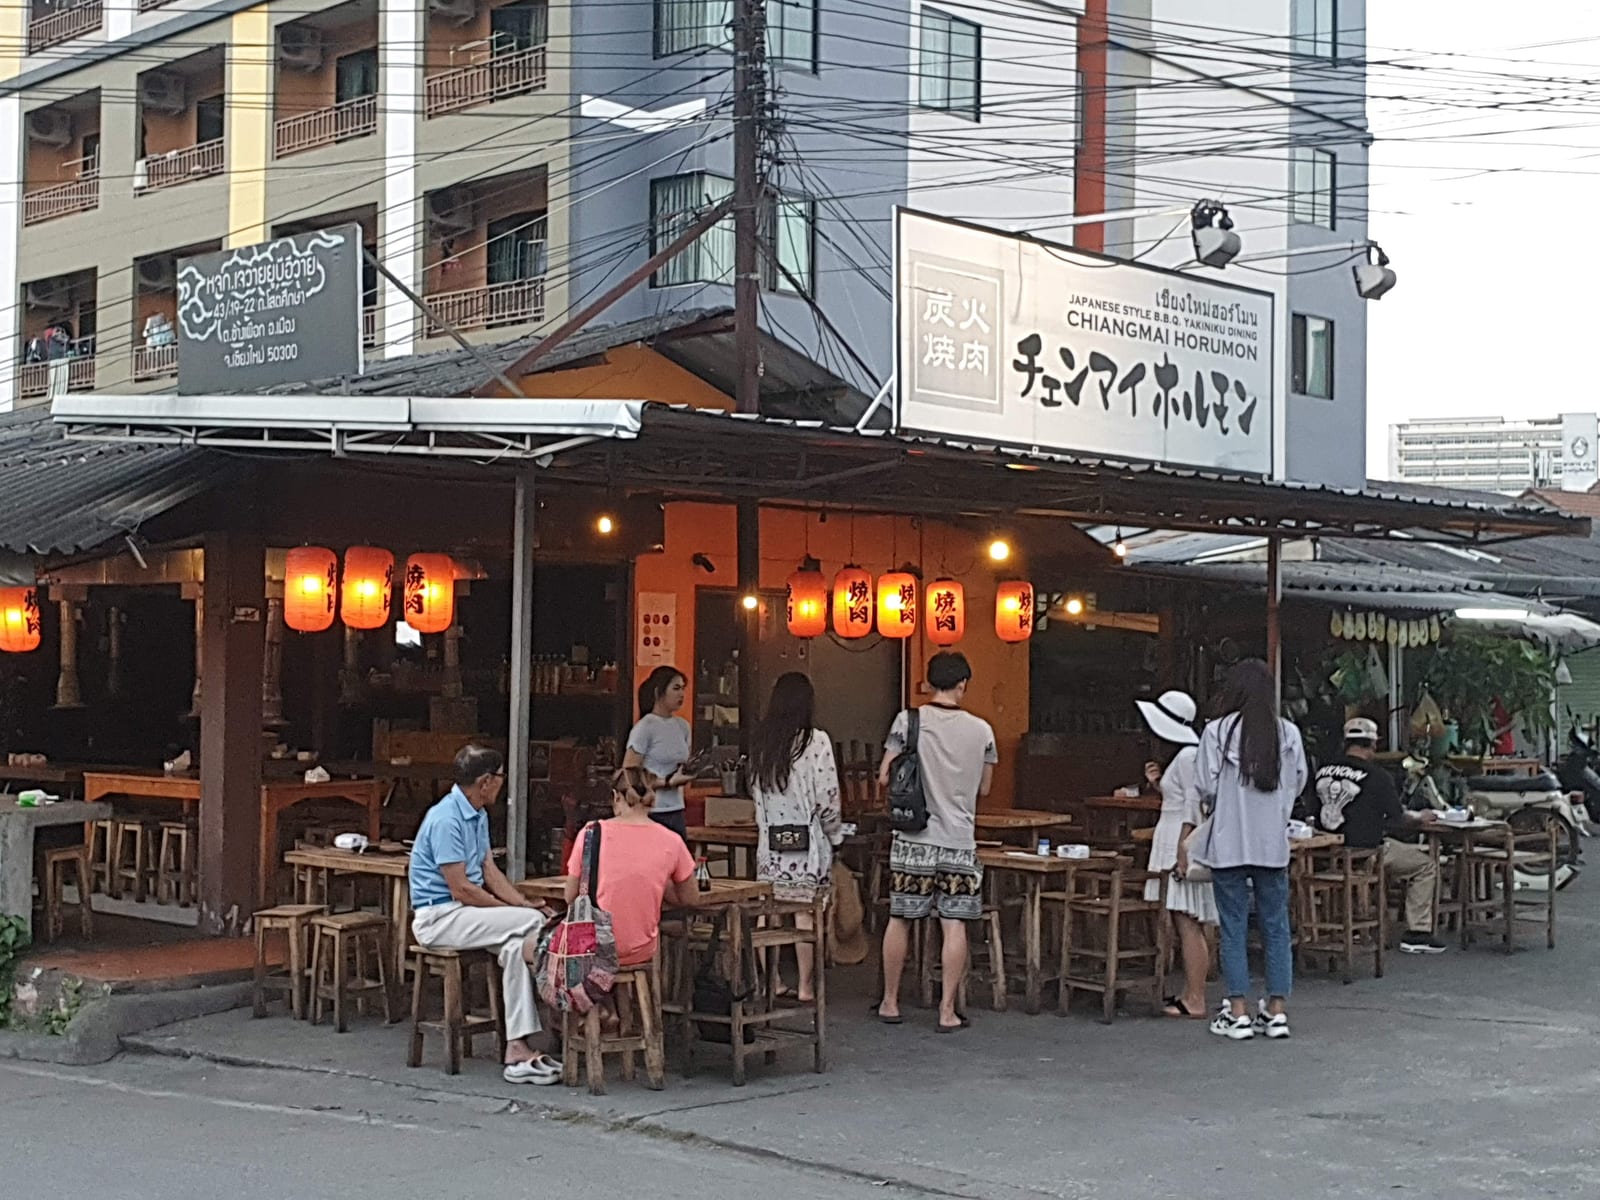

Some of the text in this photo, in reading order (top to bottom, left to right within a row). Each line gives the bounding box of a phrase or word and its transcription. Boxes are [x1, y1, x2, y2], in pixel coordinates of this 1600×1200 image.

[1066, 310, 1258, 361] CHIANGMAI HORUMON
[1068, 294, 1258, 341] JAPANESE STYLE B.B.Q. YAKINIKU DINING
[267, 343, 298, 362] 50300
[1012, 333, 1257, 436] チェンマイホルモン
[850, 581, 868, 624] 焼肉
[934, 591, 956, 631] 焼肉
